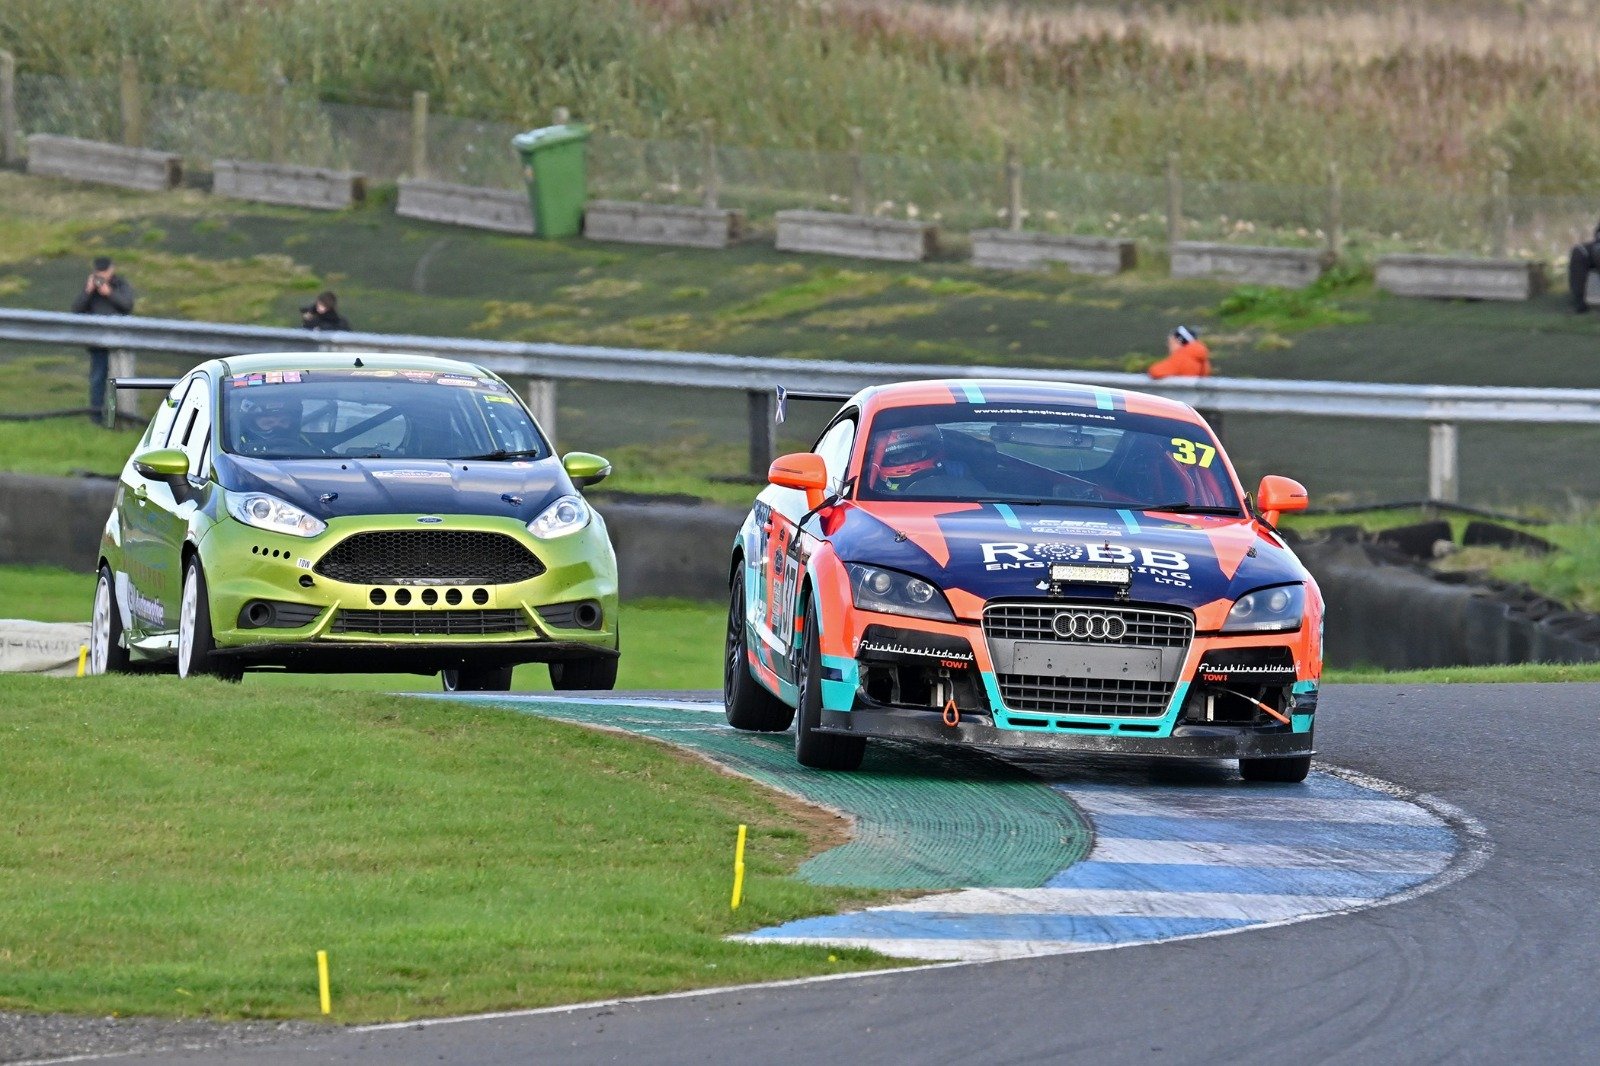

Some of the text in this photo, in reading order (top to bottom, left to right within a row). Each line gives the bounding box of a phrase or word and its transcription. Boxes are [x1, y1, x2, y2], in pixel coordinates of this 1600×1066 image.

[973, 408, 1116, 421] www.robb-engineering.co.uk
[1170, 437, 1216, 469] 37
[979, 542, 1190, 571] ROBB
[985, 562, 1192, 581] ENGING
[1154, 576, 1193, 589] LTD.
